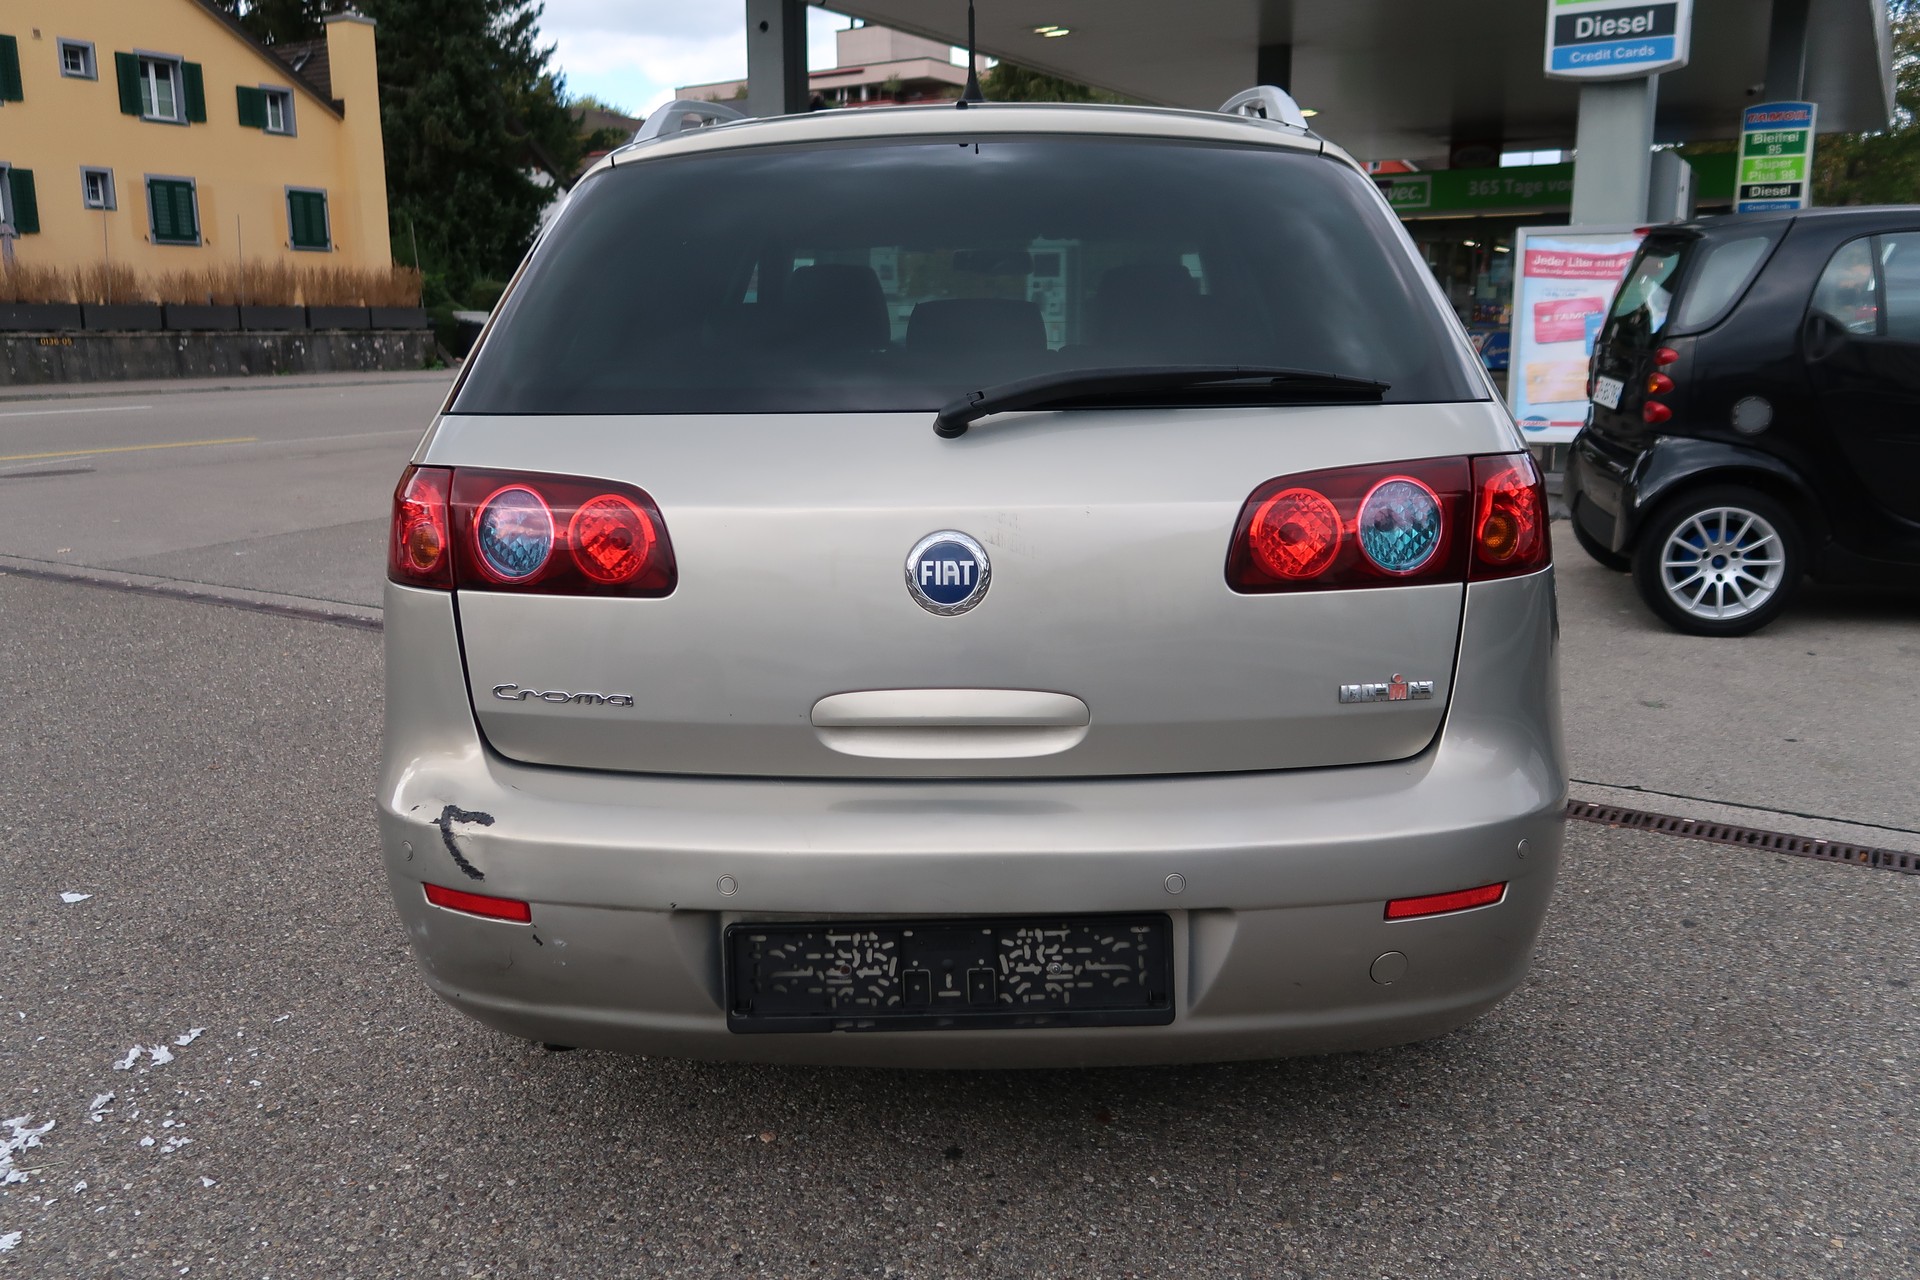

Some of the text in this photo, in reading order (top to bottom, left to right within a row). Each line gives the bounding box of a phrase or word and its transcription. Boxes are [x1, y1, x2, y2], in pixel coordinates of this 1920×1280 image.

[1575, 10, 1654, 39] Diesel
[1570, 45, 1655, 63] Credit Cards
[1748, 110, 1809, 123] TAMOIL
[1752, 132, 1800, 145] Bleifrei
[1767, 144, 1782, 154] 95
[1754, 159, 1793, 170] Super
[1468, 179, 1500, 196] 365
[1504, 178, 1544, 198] Tage
[1749, 185, 1792, 197] Diesel
[921, 560, 974, 586] FIAT
[492, 683, 634, 707] Croma
